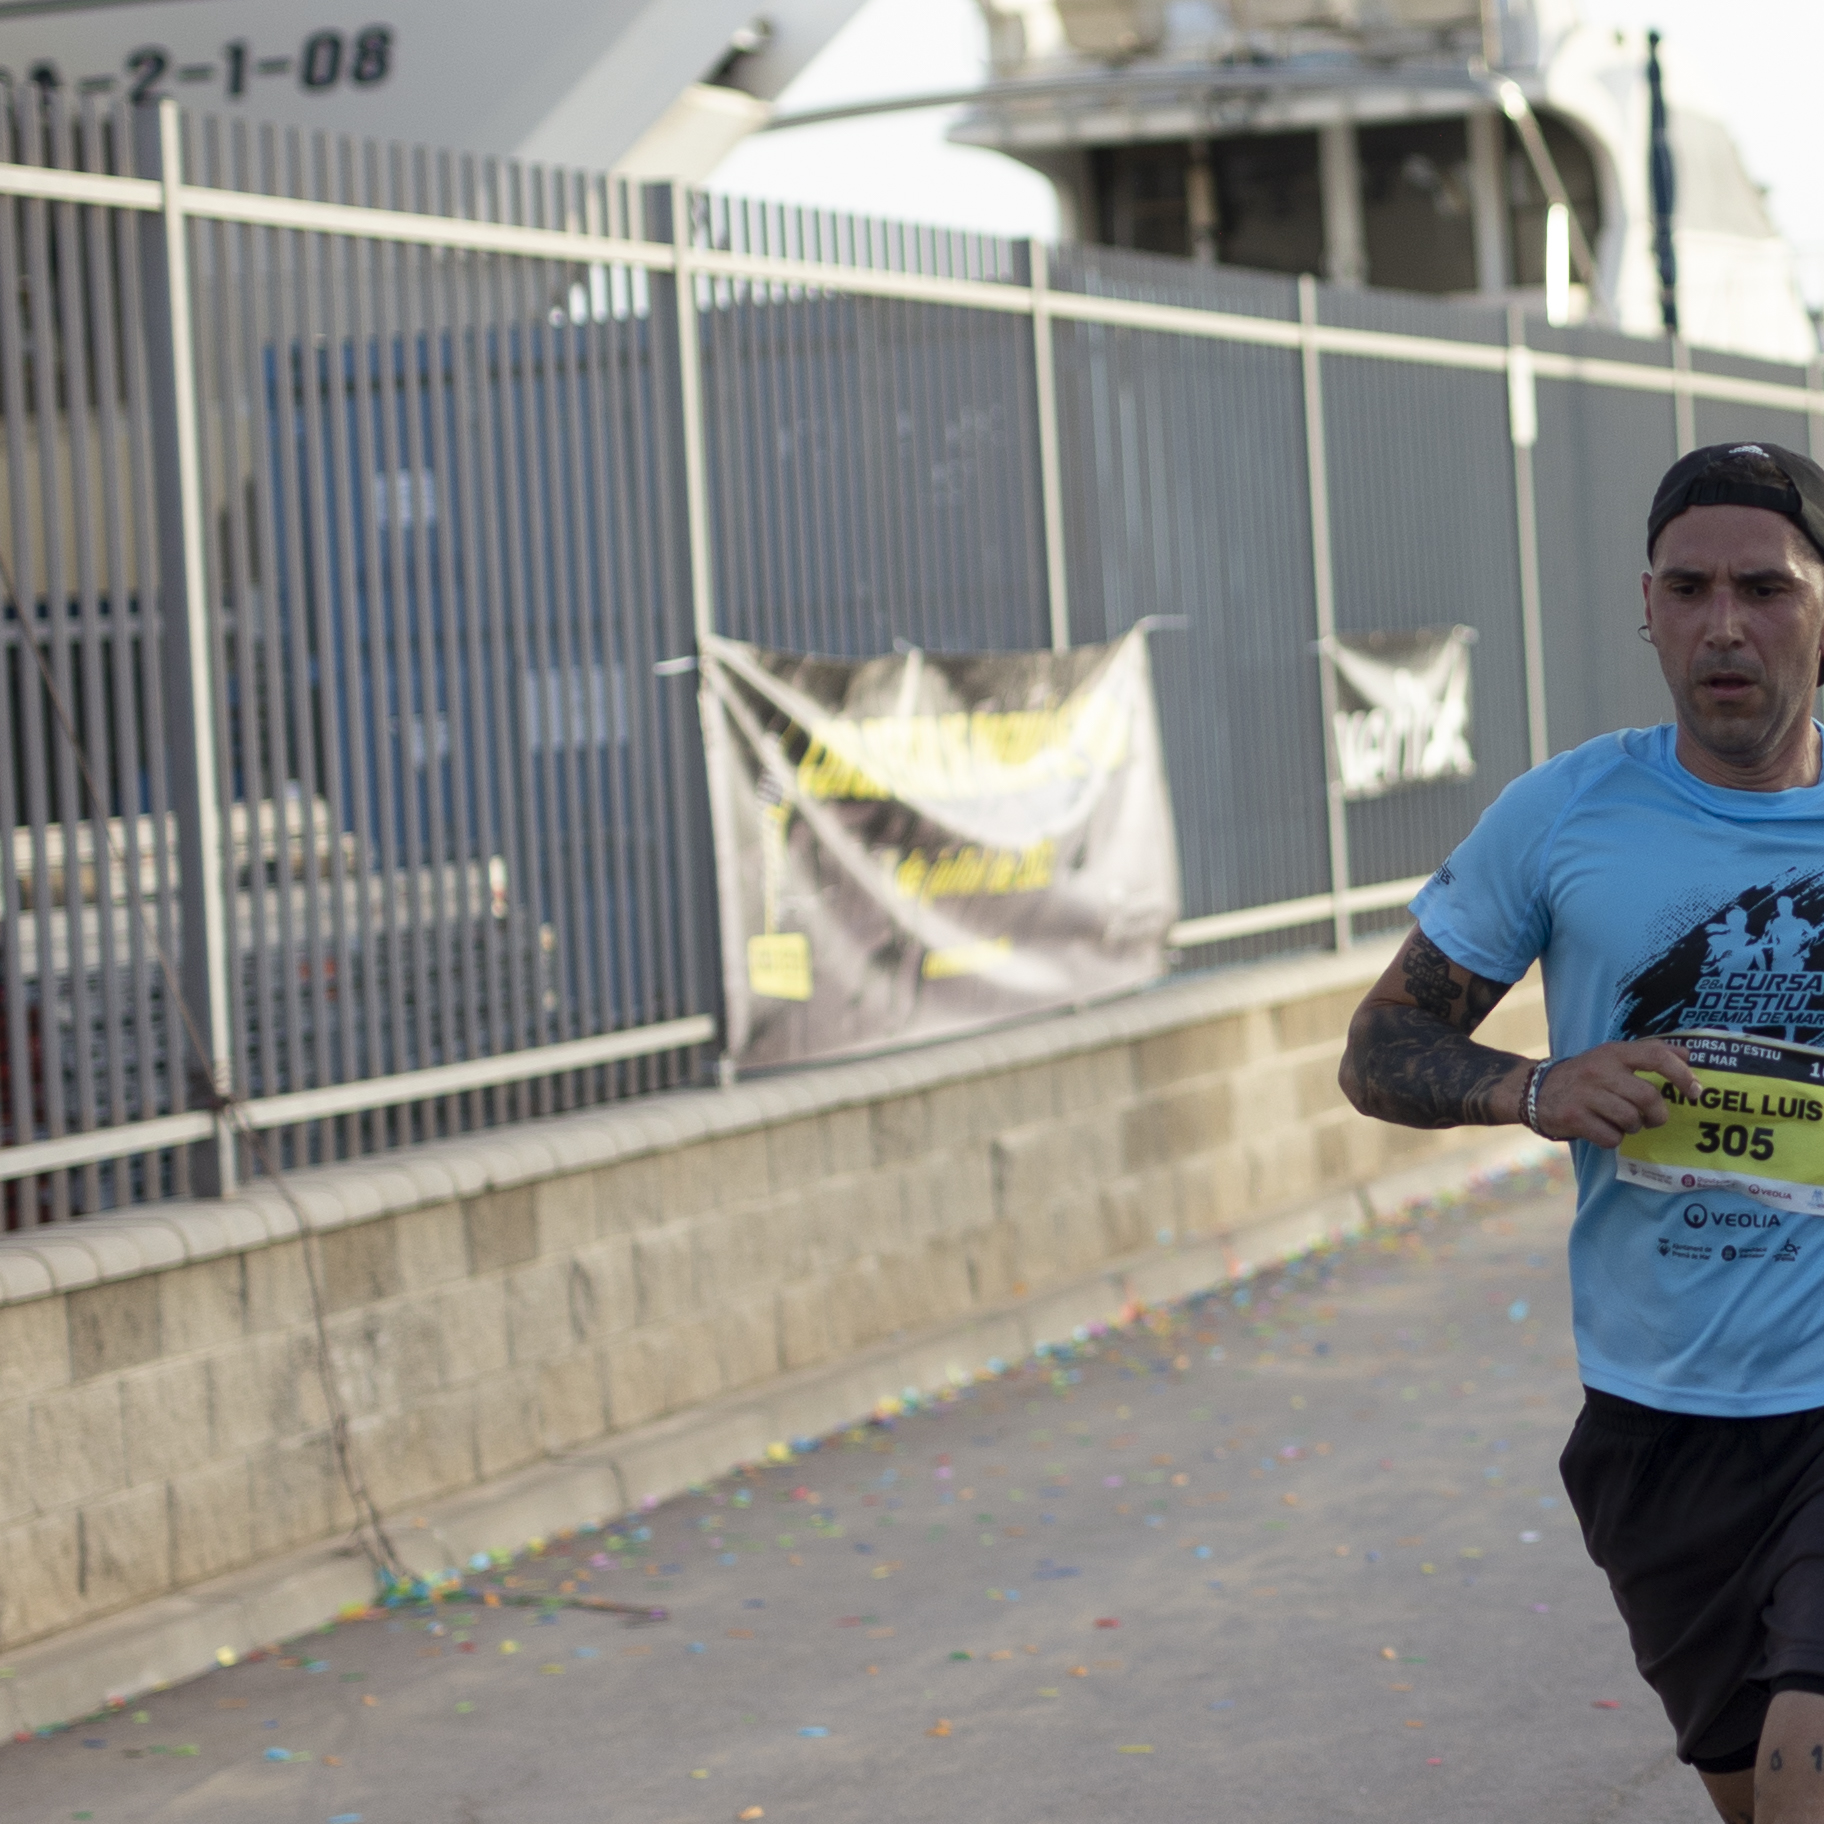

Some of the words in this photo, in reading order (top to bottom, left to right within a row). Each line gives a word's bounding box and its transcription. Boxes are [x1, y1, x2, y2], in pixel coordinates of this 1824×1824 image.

[1725, 972, 1823, 992] CURSA
[1699, 993, 1807, 1010] D'ESTIU
[1756, 1012, 1780, 1024] DE
[1686, 1038, 1727, 1053] CURSA
[1731, 1043, 1781, 1061] D'ESTIU
[1689, 1052, 1706, 1063] DE
[1709, 1054, 1737, 1067] MAR
[1761, 1095, 1823, 1121] LUIS
[1695, 1121, 1774, 1161] 305
[1761, 1188, 1792, 1200] VEOLIA
[1711, 1212, 1781, 1228] VEOLIA
